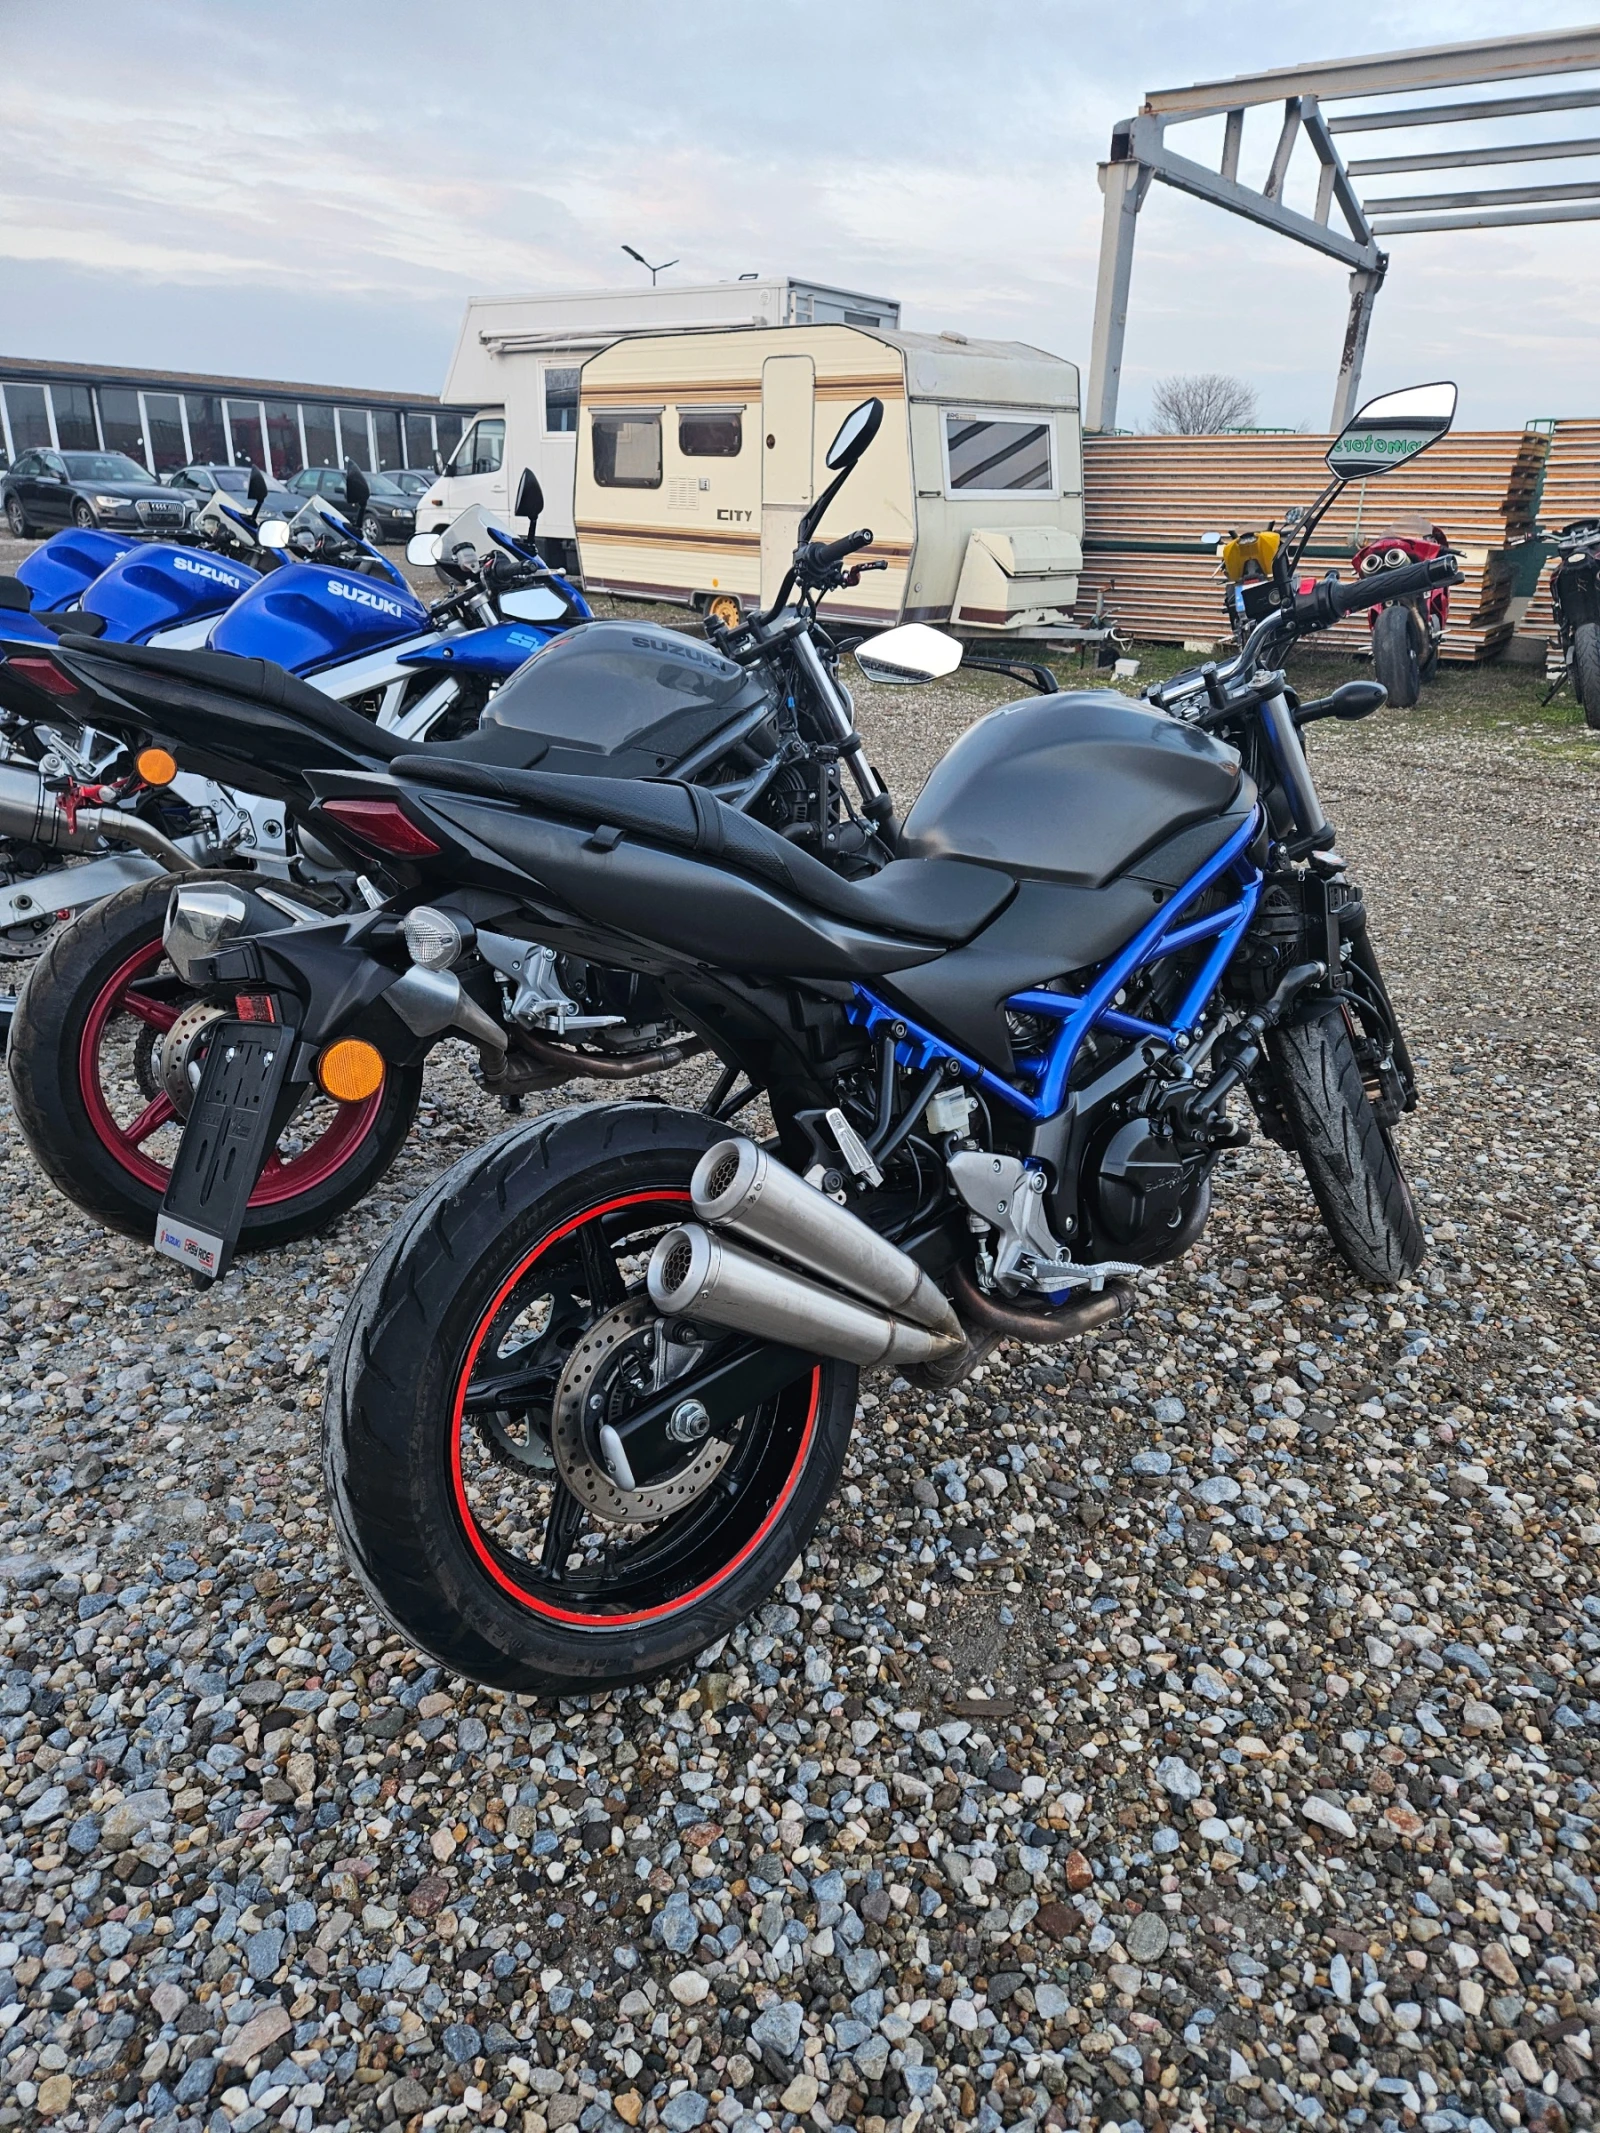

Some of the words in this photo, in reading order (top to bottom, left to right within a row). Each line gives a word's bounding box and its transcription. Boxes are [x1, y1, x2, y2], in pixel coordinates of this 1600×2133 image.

[716, 508, 752, 522] CITY
[173, 556, 240, 589] SUZUKI
[327, 579, 402, 618] SUZUKI
[631, 636, 726, 672] SUZUKI
[165, 1233, 181, 1248] SUZUKI
